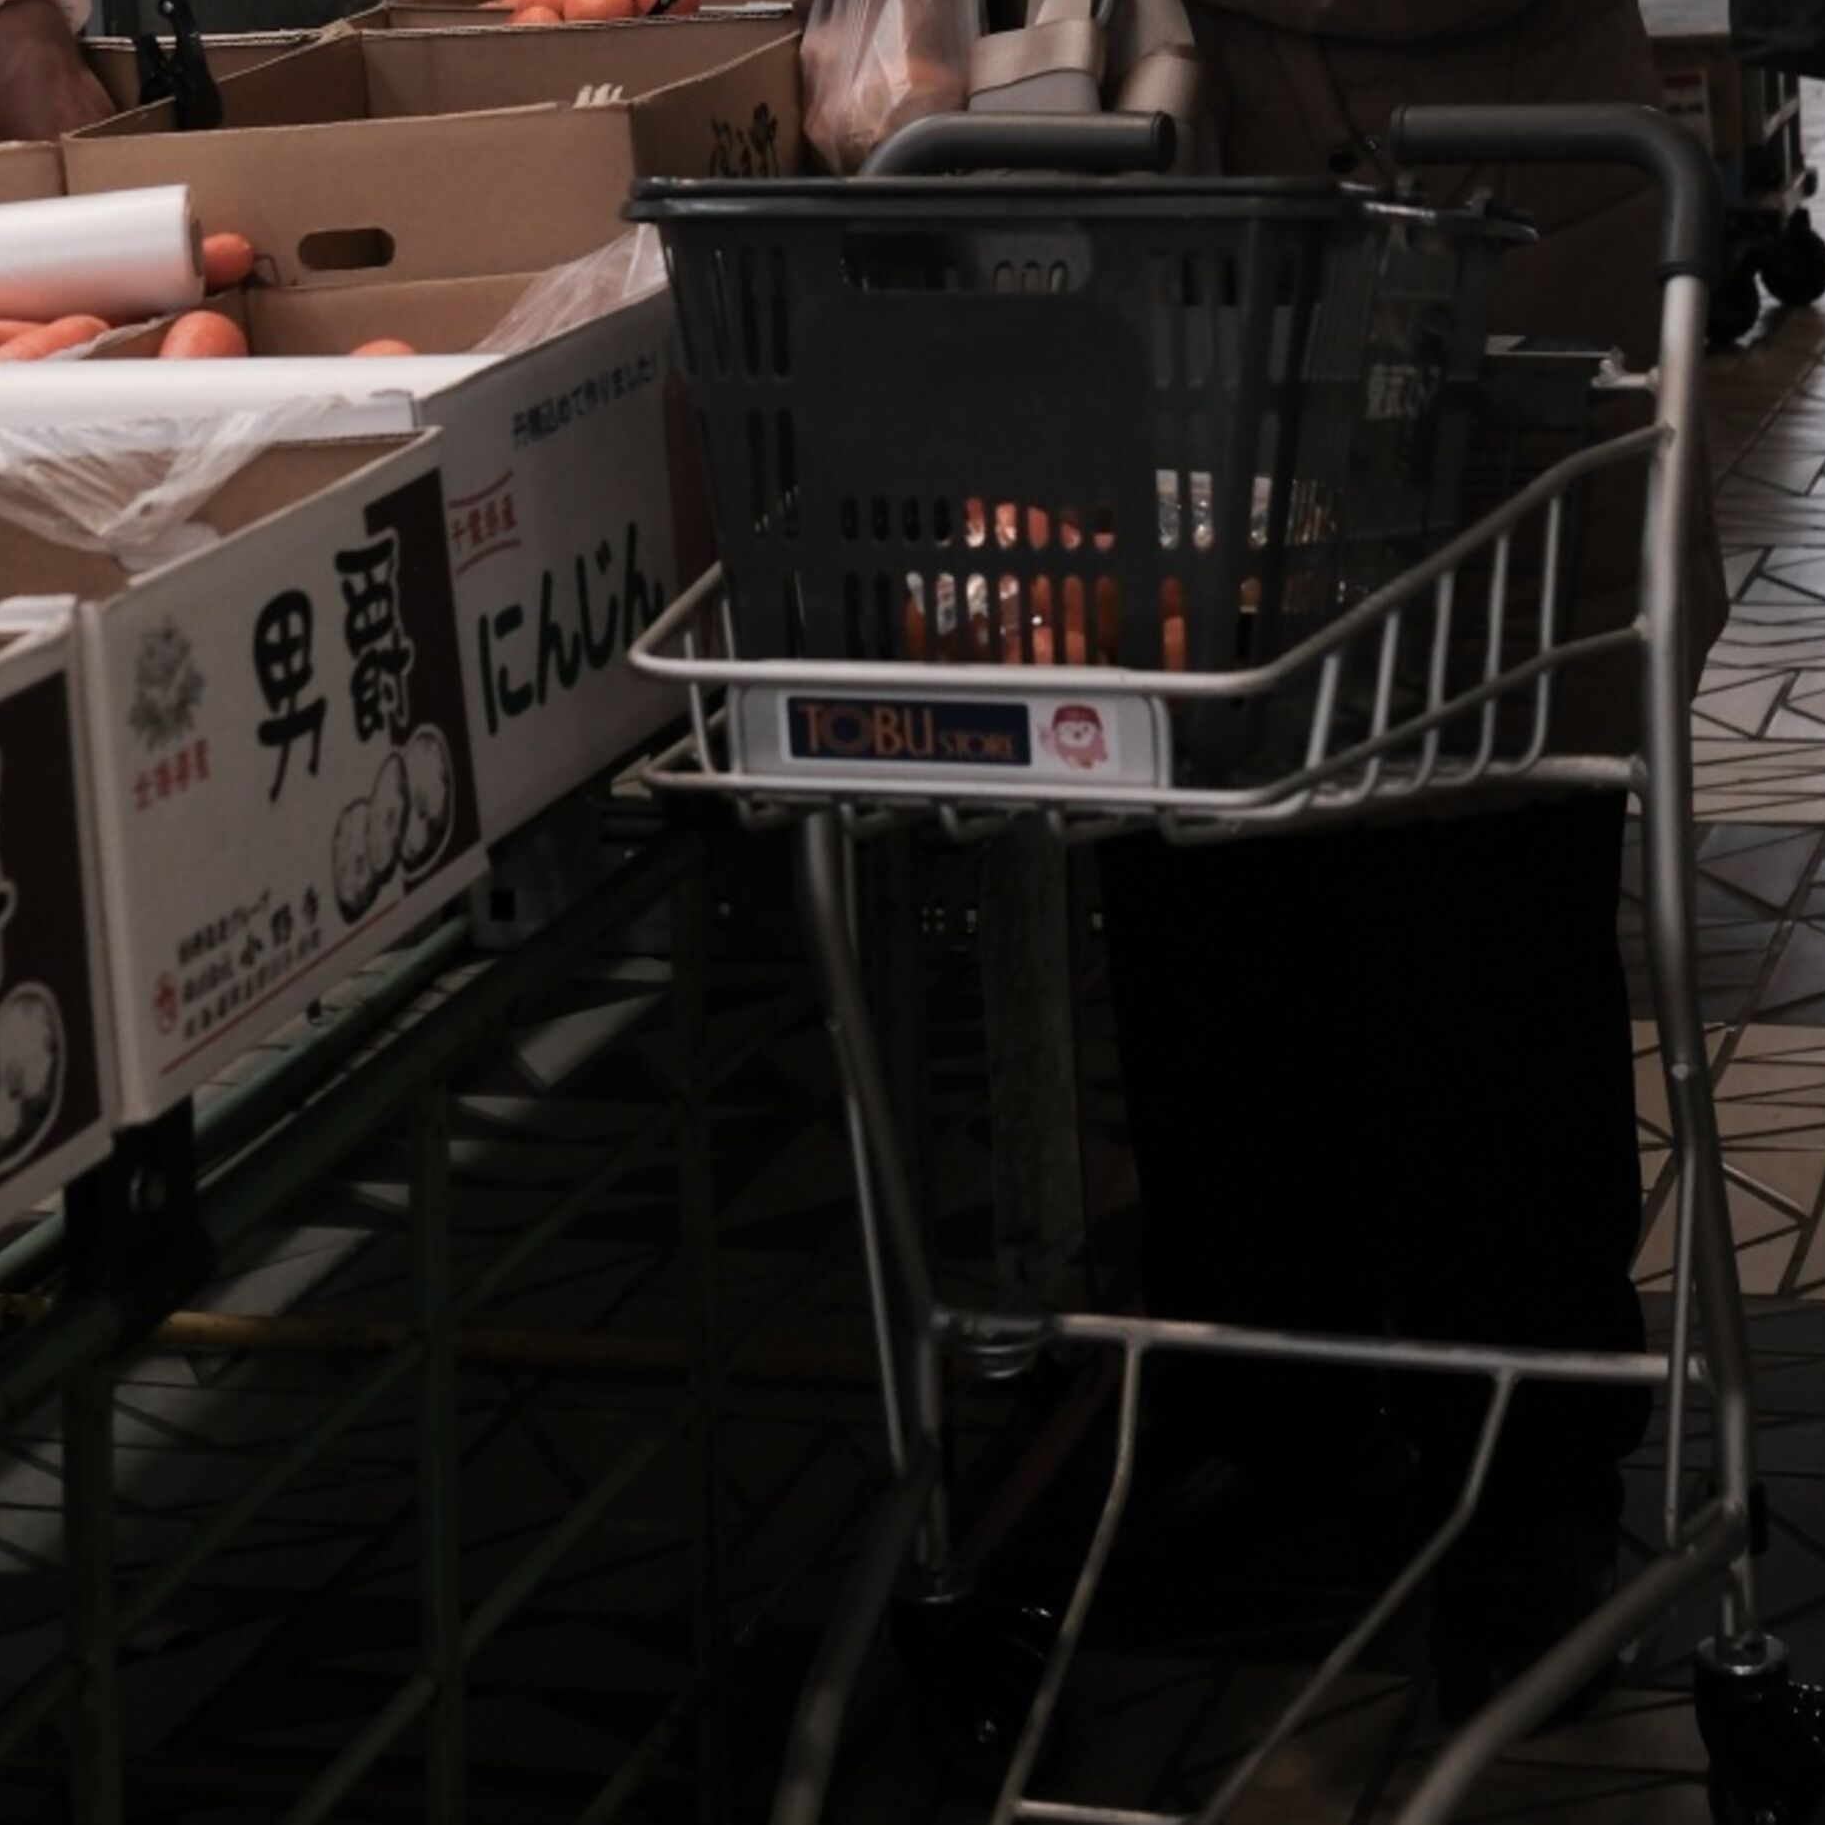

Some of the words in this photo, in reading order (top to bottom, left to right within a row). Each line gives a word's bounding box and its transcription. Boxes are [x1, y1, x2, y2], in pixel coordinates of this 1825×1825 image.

[255, 537, 412, 803] 男爵
[477, 523, 666, 736] にんじん
[797, 700, 936, 757] TOBU
[939, 728, 1019, 762] STORE
